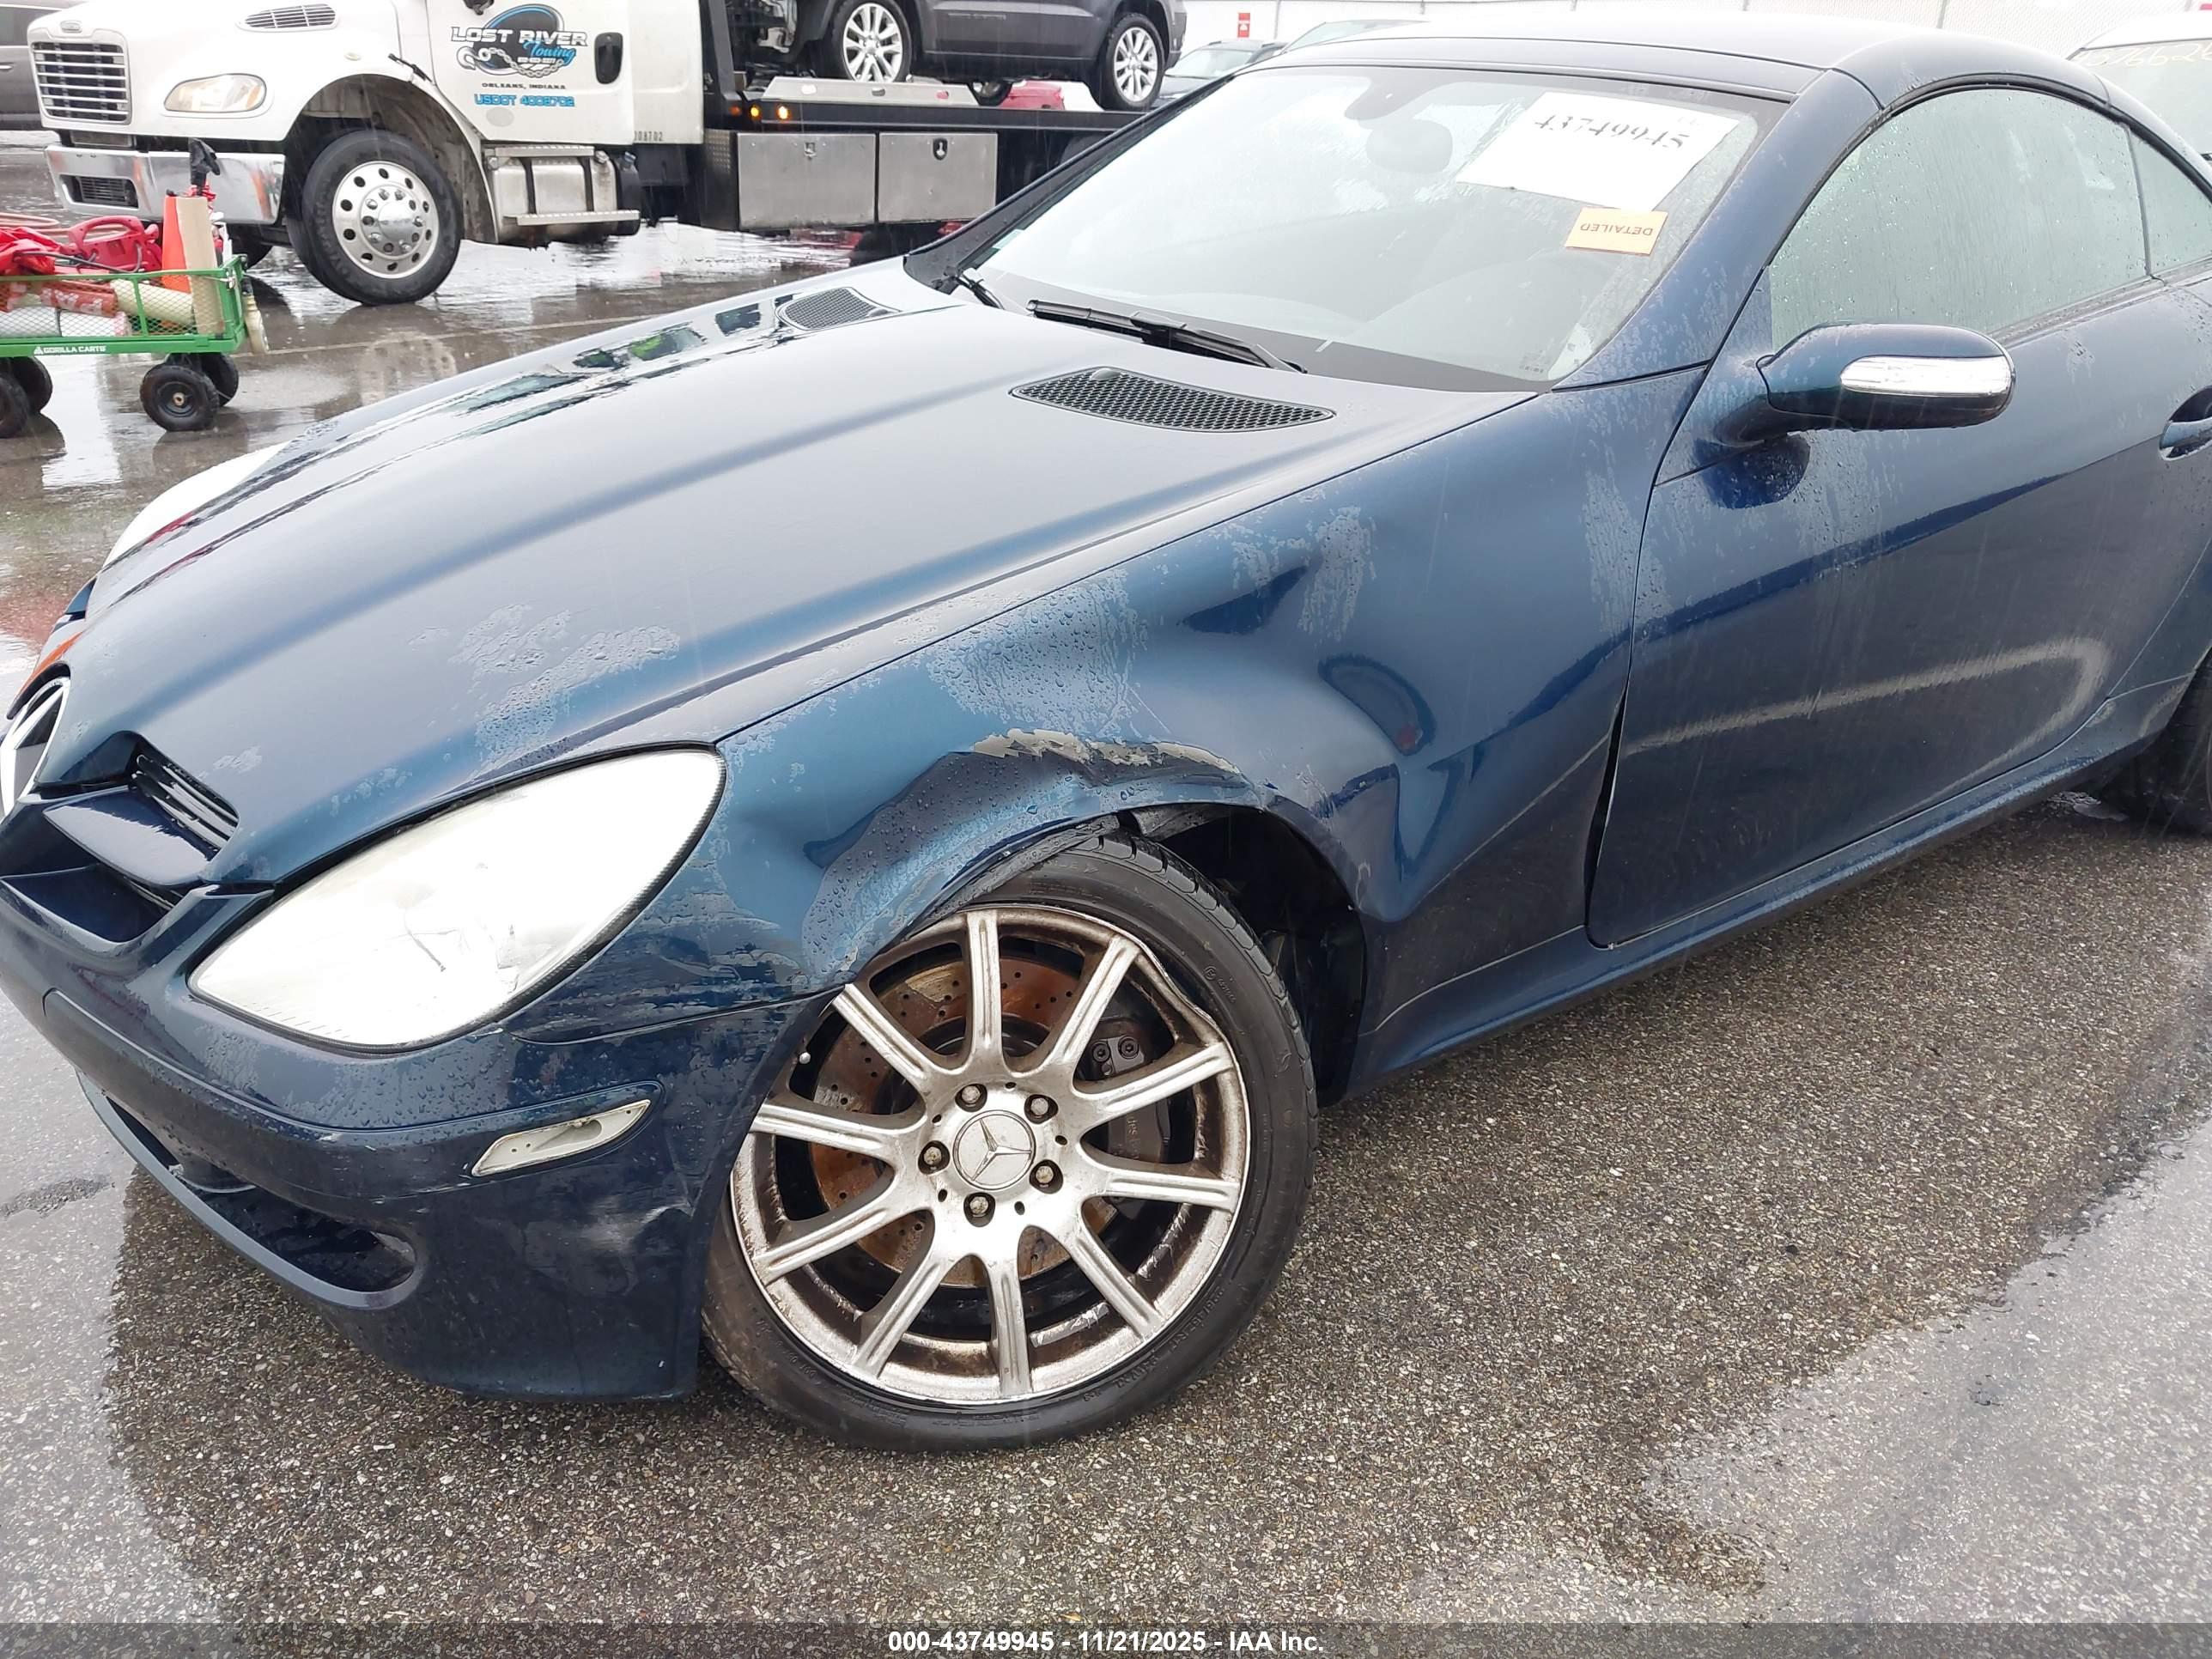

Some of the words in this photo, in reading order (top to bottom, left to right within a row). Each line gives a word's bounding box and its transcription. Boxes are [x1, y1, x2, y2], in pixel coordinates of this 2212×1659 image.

[451, 27, 513, 43] LOST
[519, 30, 588, 46] RIVER
[522, 40, 577, 66] Towing
[474, 94, 517, 106] USDOT
[1534, 115, 1690, 148] 43749945
[1580, 222, 1655, 237] DETAILED
[44, 346, 77, 355] GORILLA
